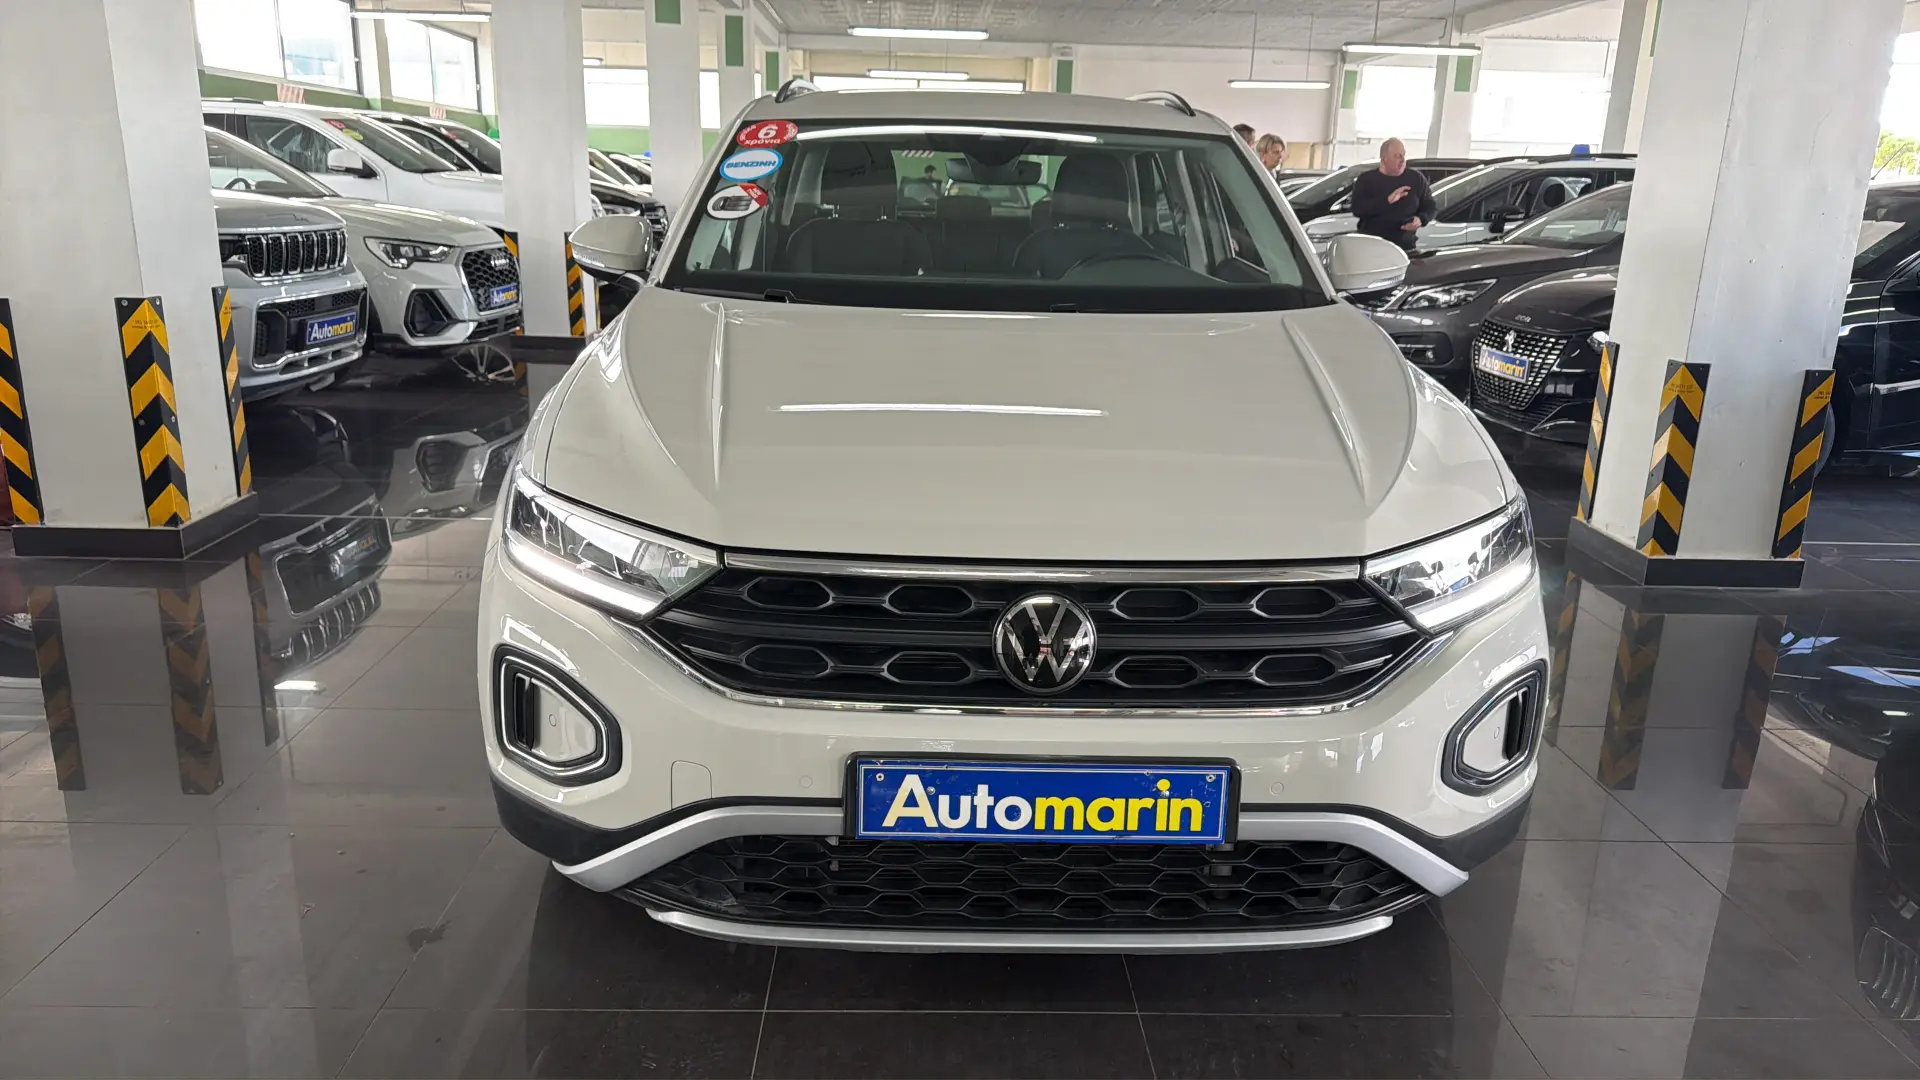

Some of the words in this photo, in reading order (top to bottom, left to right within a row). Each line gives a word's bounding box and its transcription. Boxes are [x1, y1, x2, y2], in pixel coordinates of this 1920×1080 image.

[758, 125, 778, 139] 6
[310, 316, 353, 341] Automarin
[881, 773, 1203, 832] Automarin
